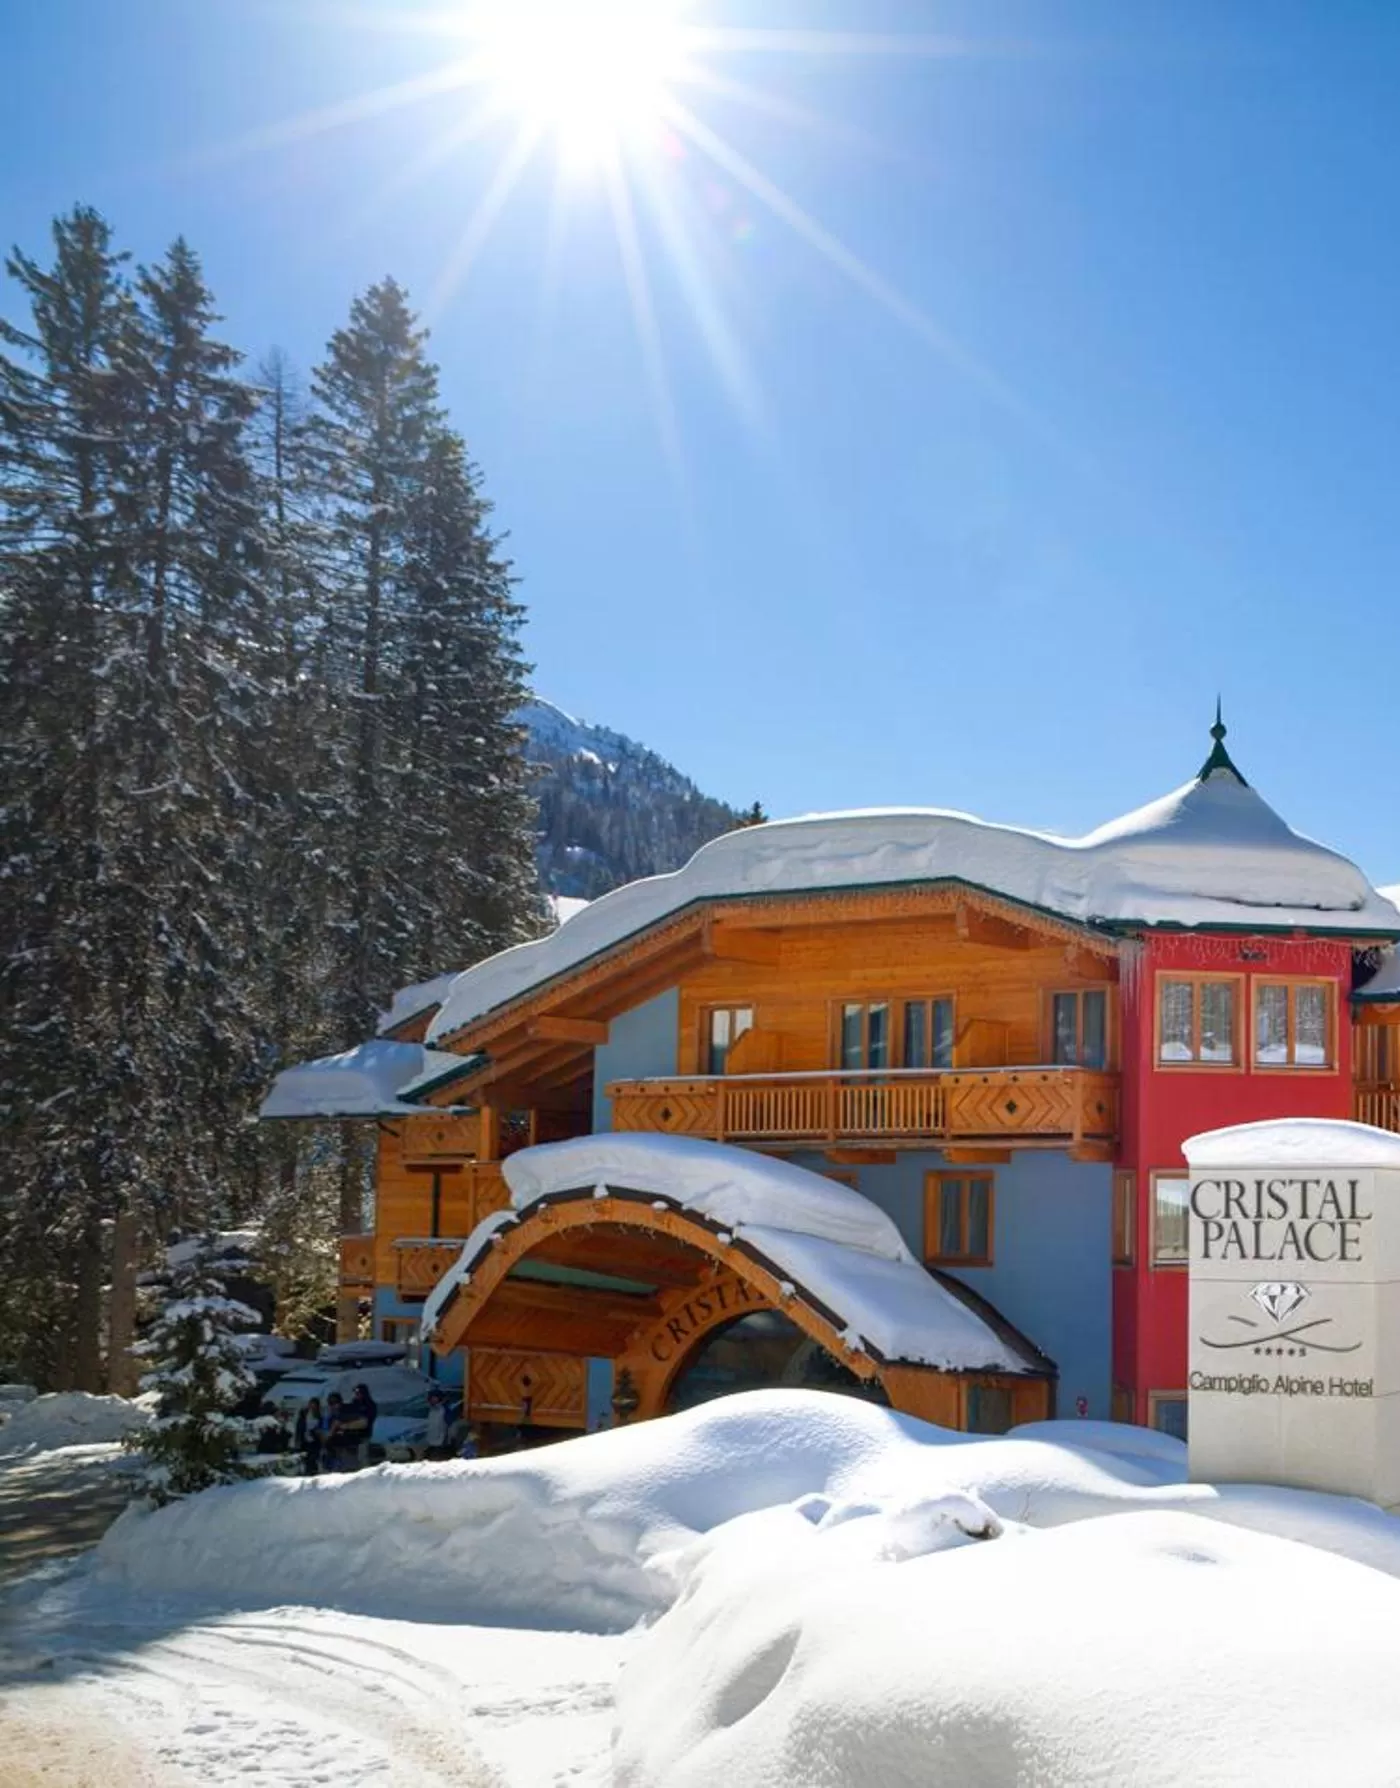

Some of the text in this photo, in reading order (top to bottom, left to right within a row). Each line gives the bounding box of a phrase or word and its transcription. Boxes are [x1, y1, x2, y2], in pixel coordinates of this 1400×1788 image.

[1190, 1179, 1373, 1220] CRISTAL
[1201, 1220, 1363, 1262] PALACE
[651, 1278, 766, 1362] CRISTA
[1189, 1371, 1374, 1397] Campiglio Alpine Hotel
